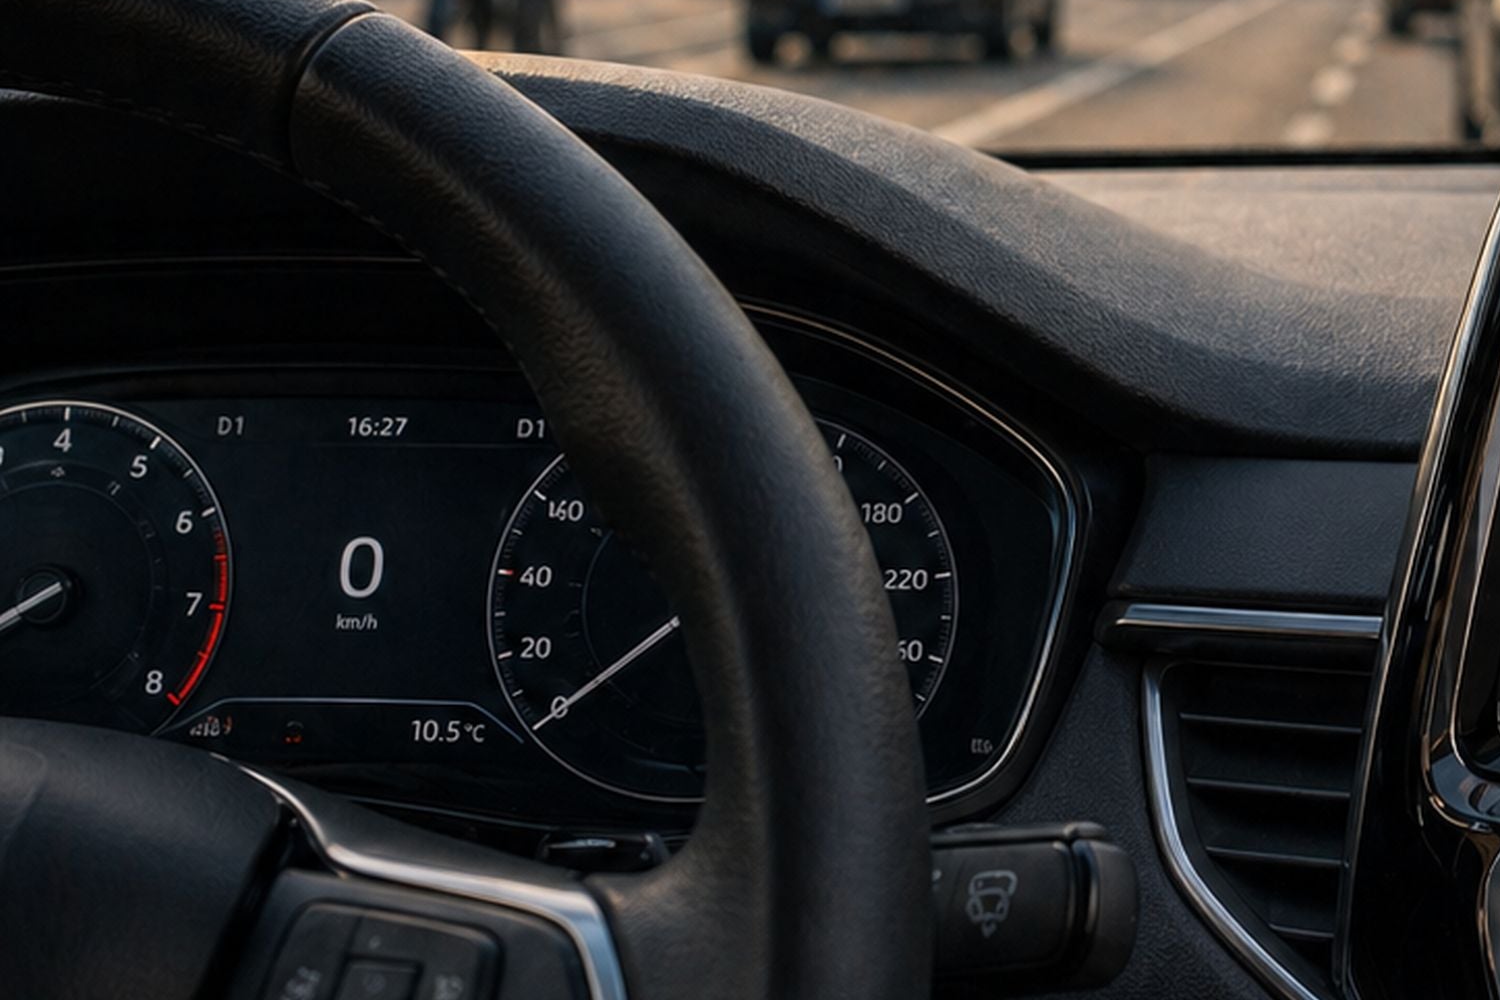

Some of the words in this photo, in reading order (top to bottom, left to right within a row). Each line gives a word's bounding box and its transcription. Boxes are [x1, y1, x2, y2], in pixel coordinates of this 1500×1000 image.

[217, 416, 244, 436] D1
[348, 417, 408, 437] 16:27
[516, 418, 545, 438] D1
[53, 428, 72, 452] 4
[129, 455, 148, 478] 5
[175, 511, 193, 533] 6
[861, 503, 902, 523] 180
[340, 536, 384, 597] 0
[519, 566, 552, 587] 40
[884, 569, 928, 590] 220
[186, 592, 203, 616] 7
[335, 613, 378, 630] km/h
[519, 637, 552, 658] 20
[145, 670, 163, 694] 8
